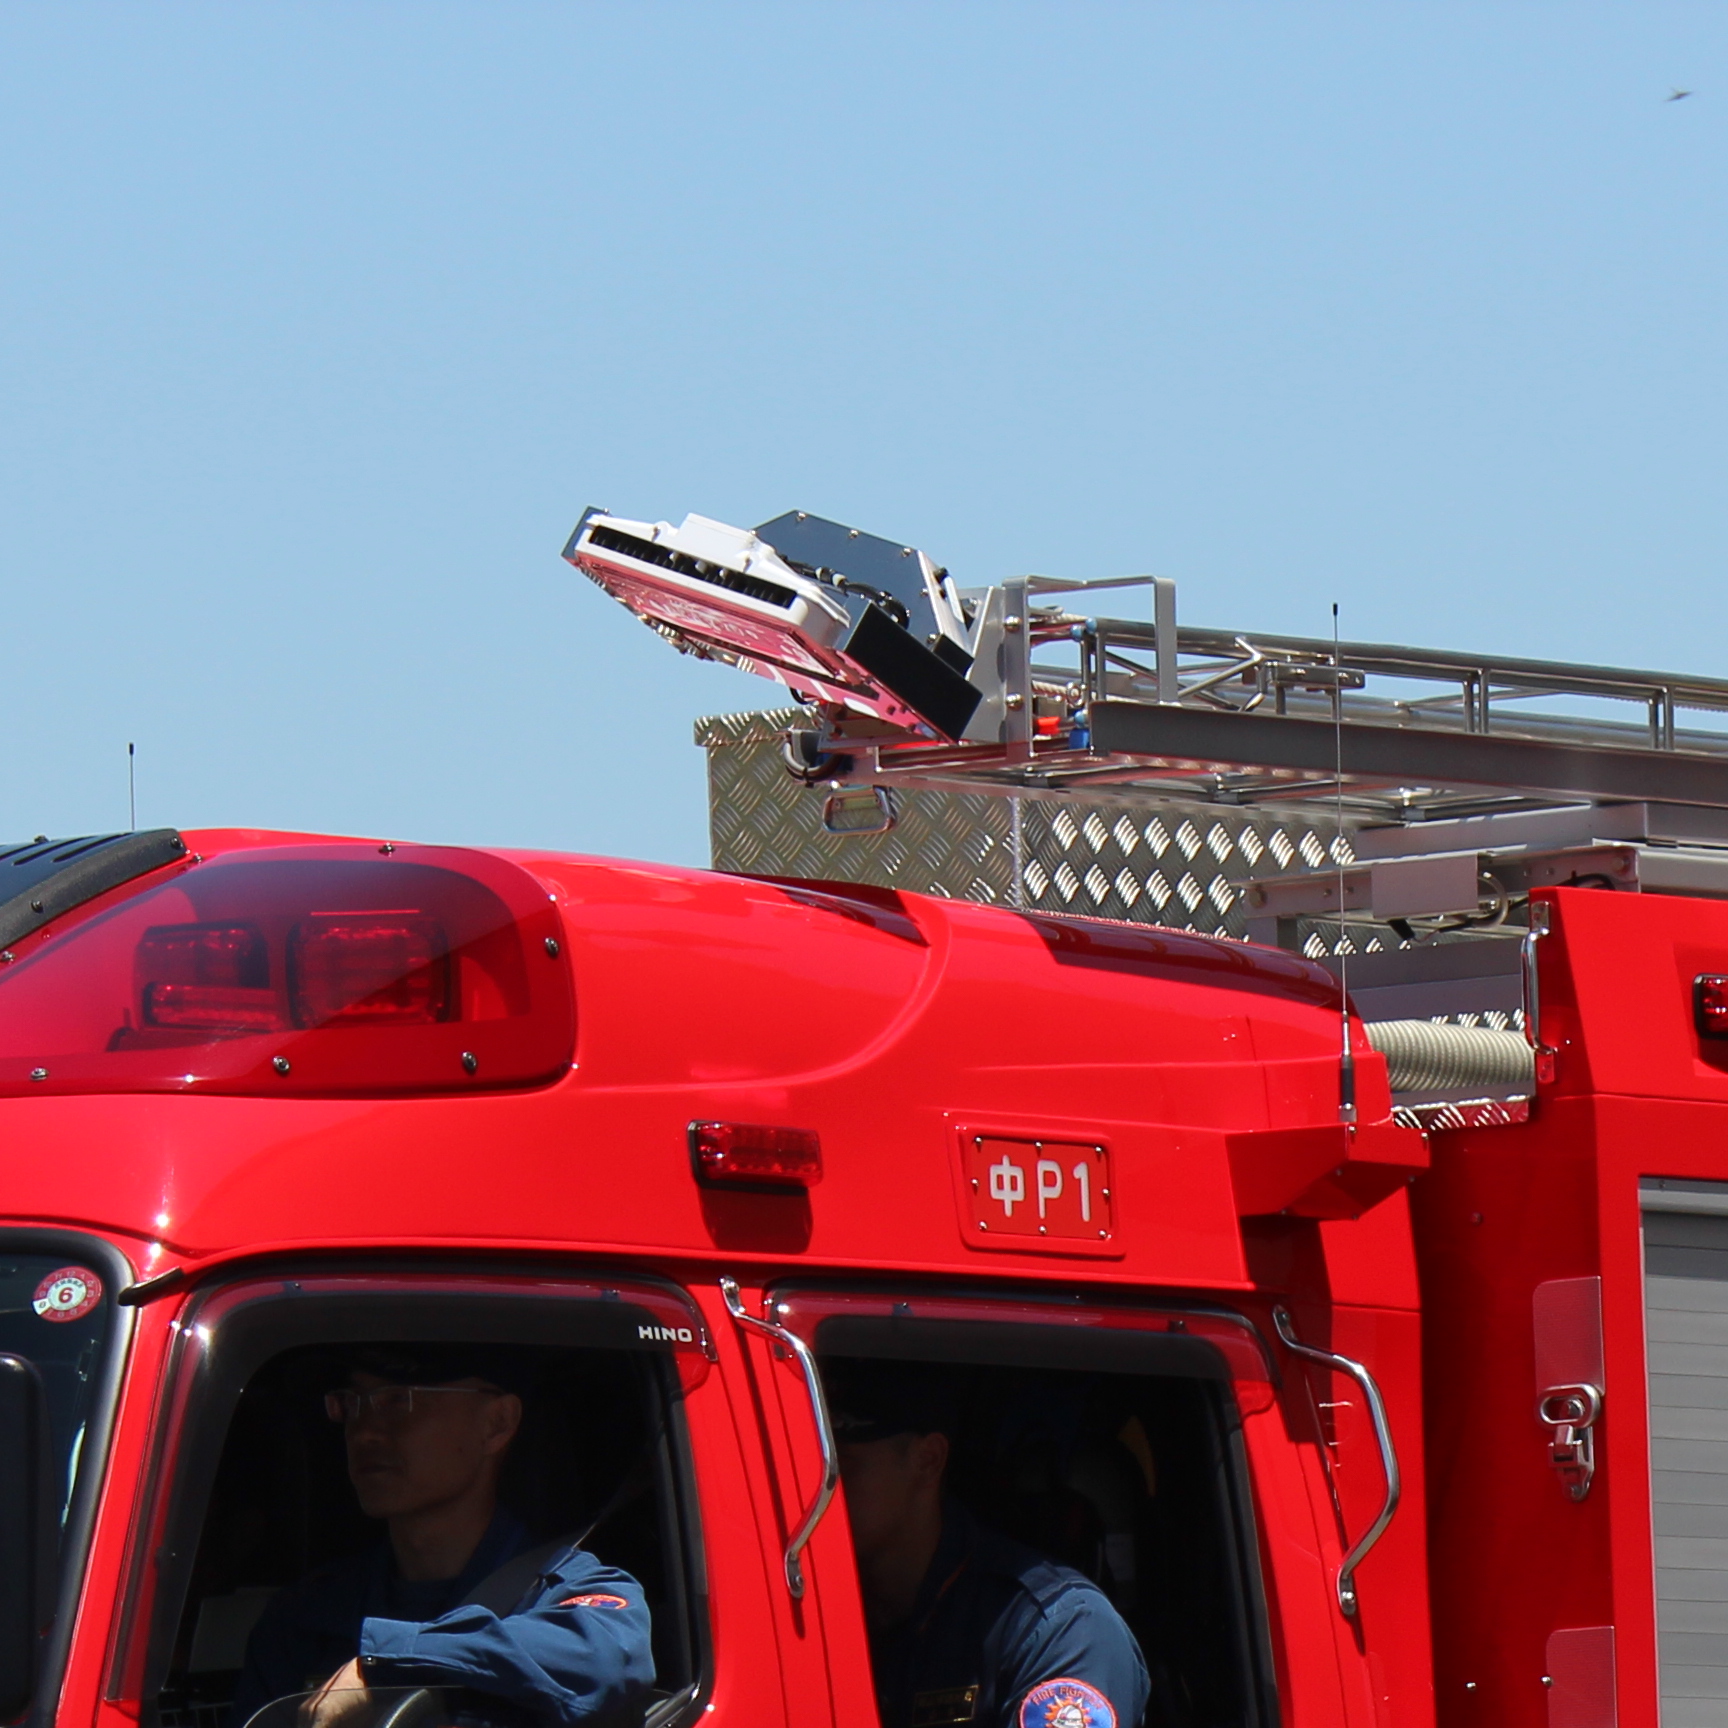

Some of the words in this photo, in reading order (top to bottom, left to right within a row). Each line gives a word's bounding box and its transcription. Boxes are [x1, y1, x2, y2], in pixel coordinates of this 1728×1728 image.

[989, 1155, 1090, 1222] 中P1
[59, 1287, 74, 1303] 6
[638, 1325, 693, 1342] HINO
